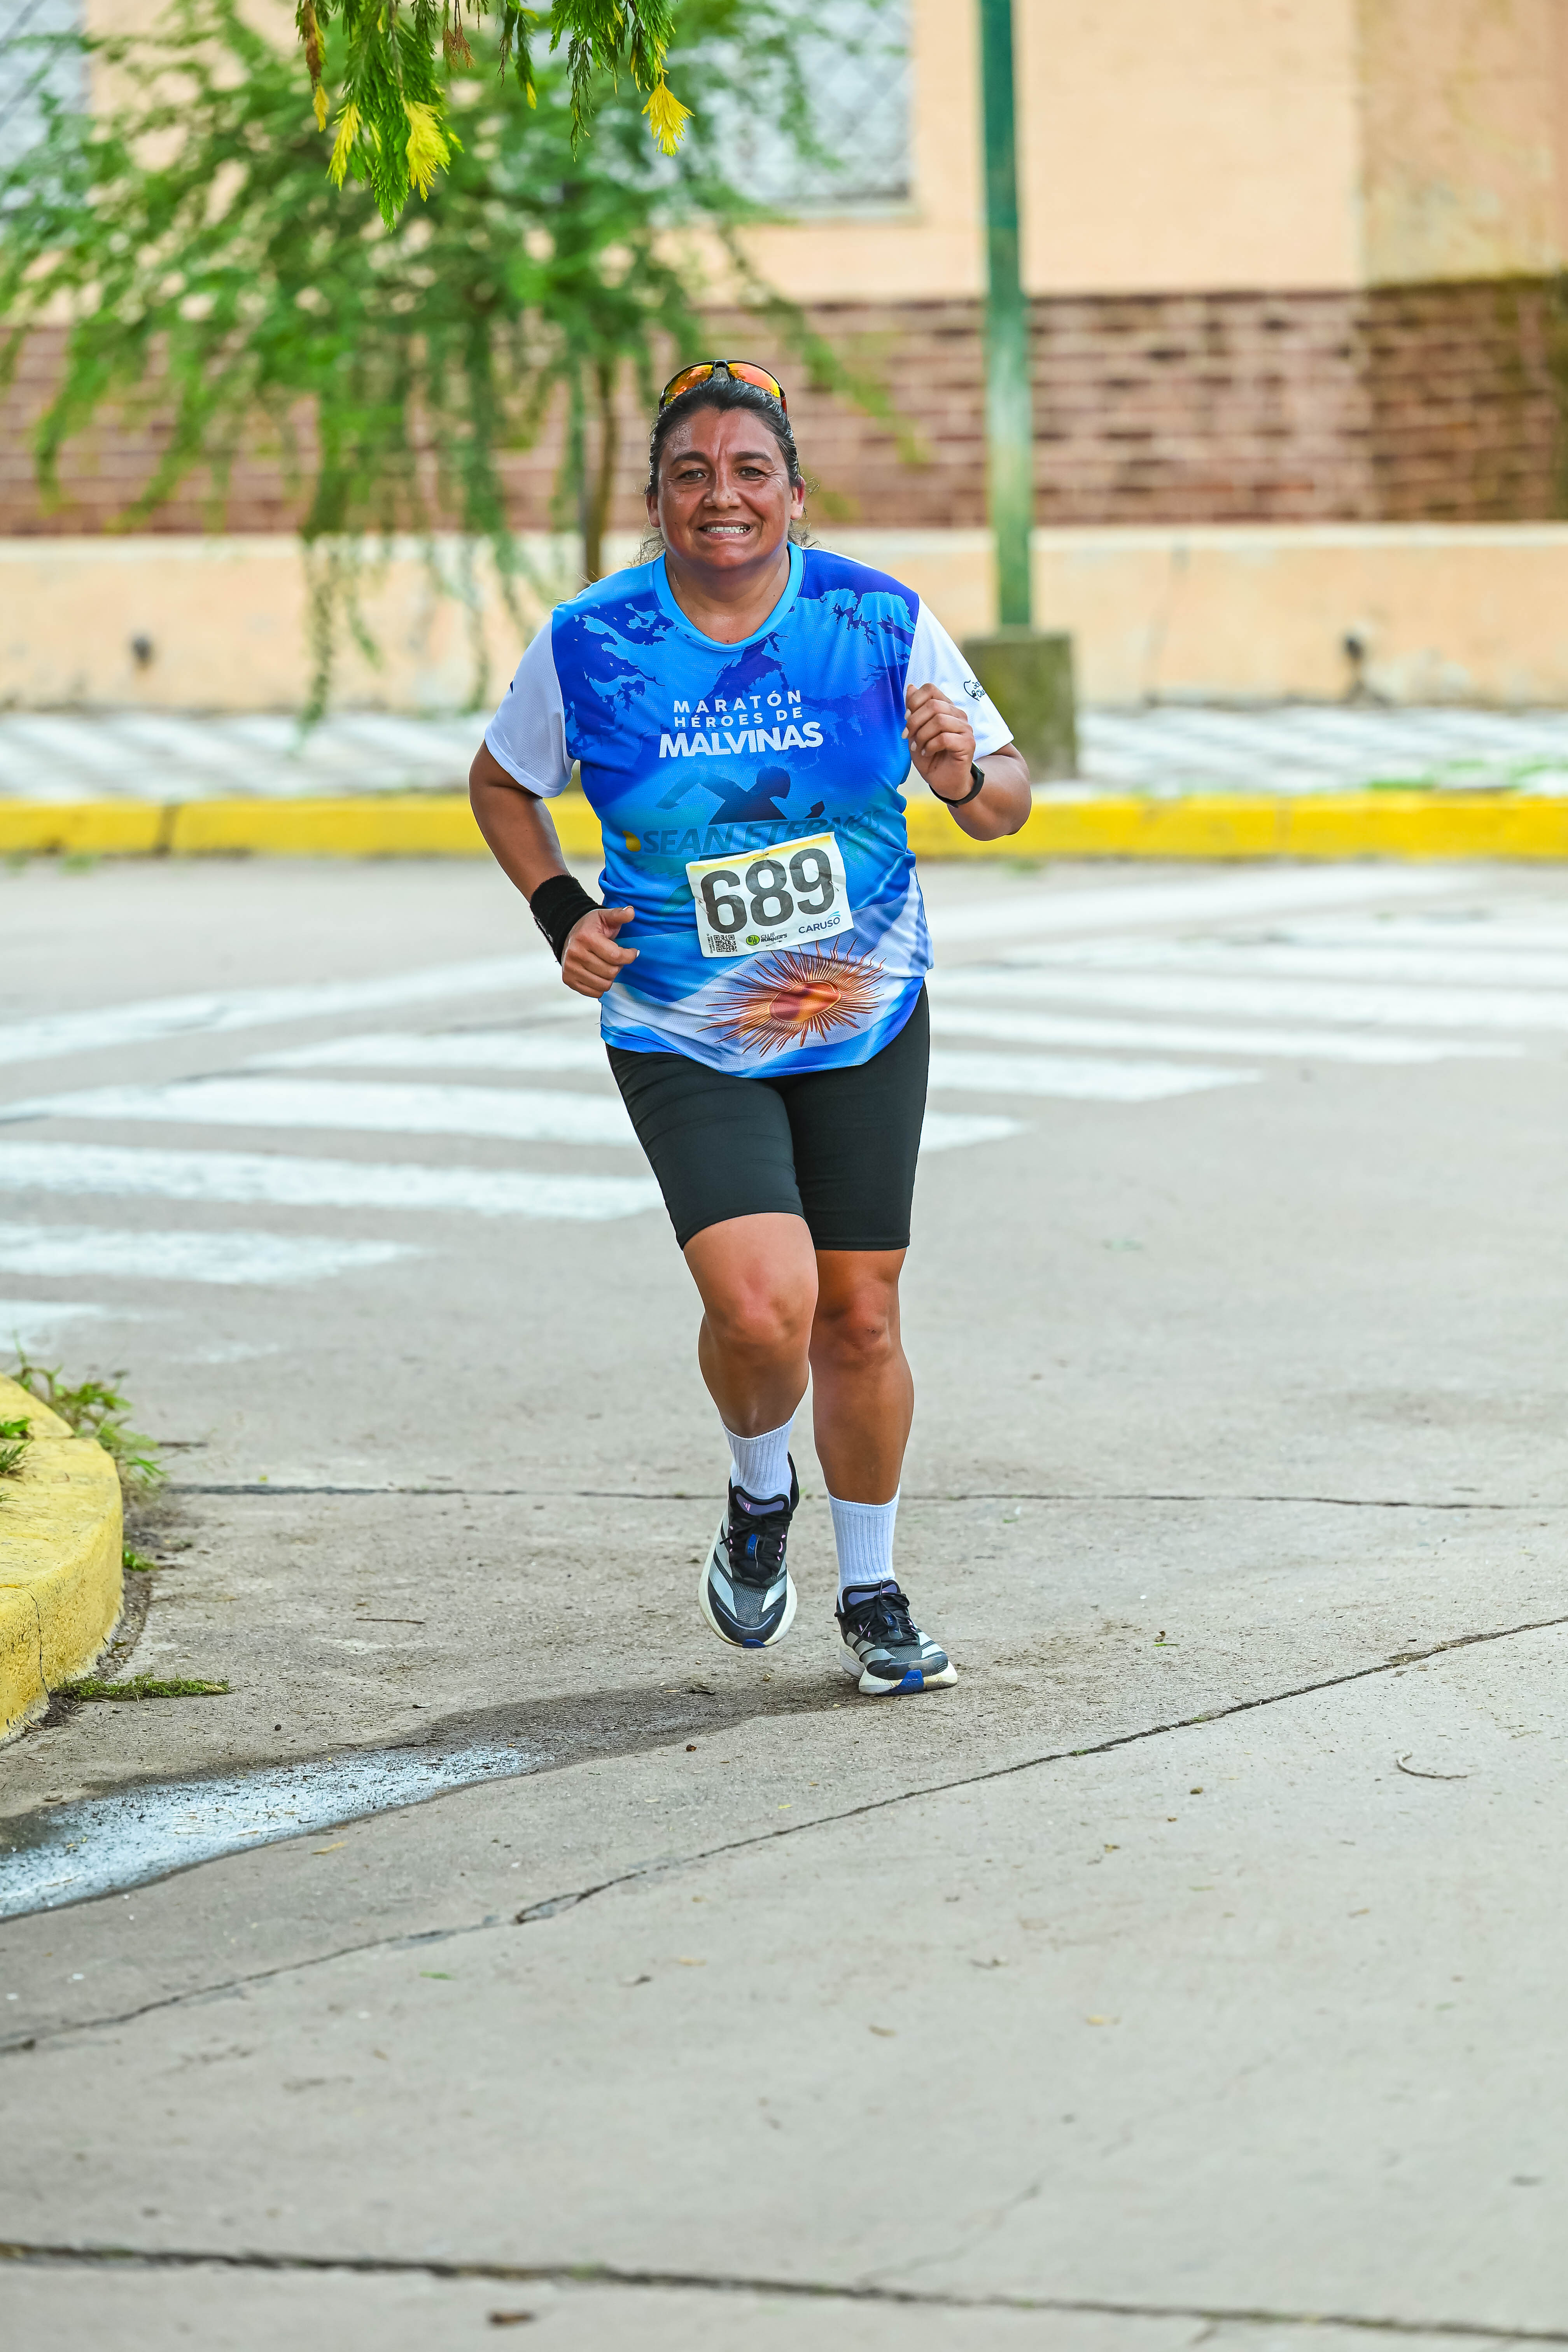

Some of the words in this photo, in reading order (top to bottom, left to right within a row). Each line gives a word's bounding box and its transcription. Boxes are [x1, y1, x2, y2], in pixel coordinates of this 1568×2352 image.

[673, 690, 801, 713] MARATÓN
[674, 712, 763, 728] HÉROES
[776, 707, 803, 721] DE
[659, 721, 824, 758] MALVINAS
[642, 824, 735, 855] SEAN
[701, 848, 835, 934] 689
[798, 917, 840, 934] CARUSO
